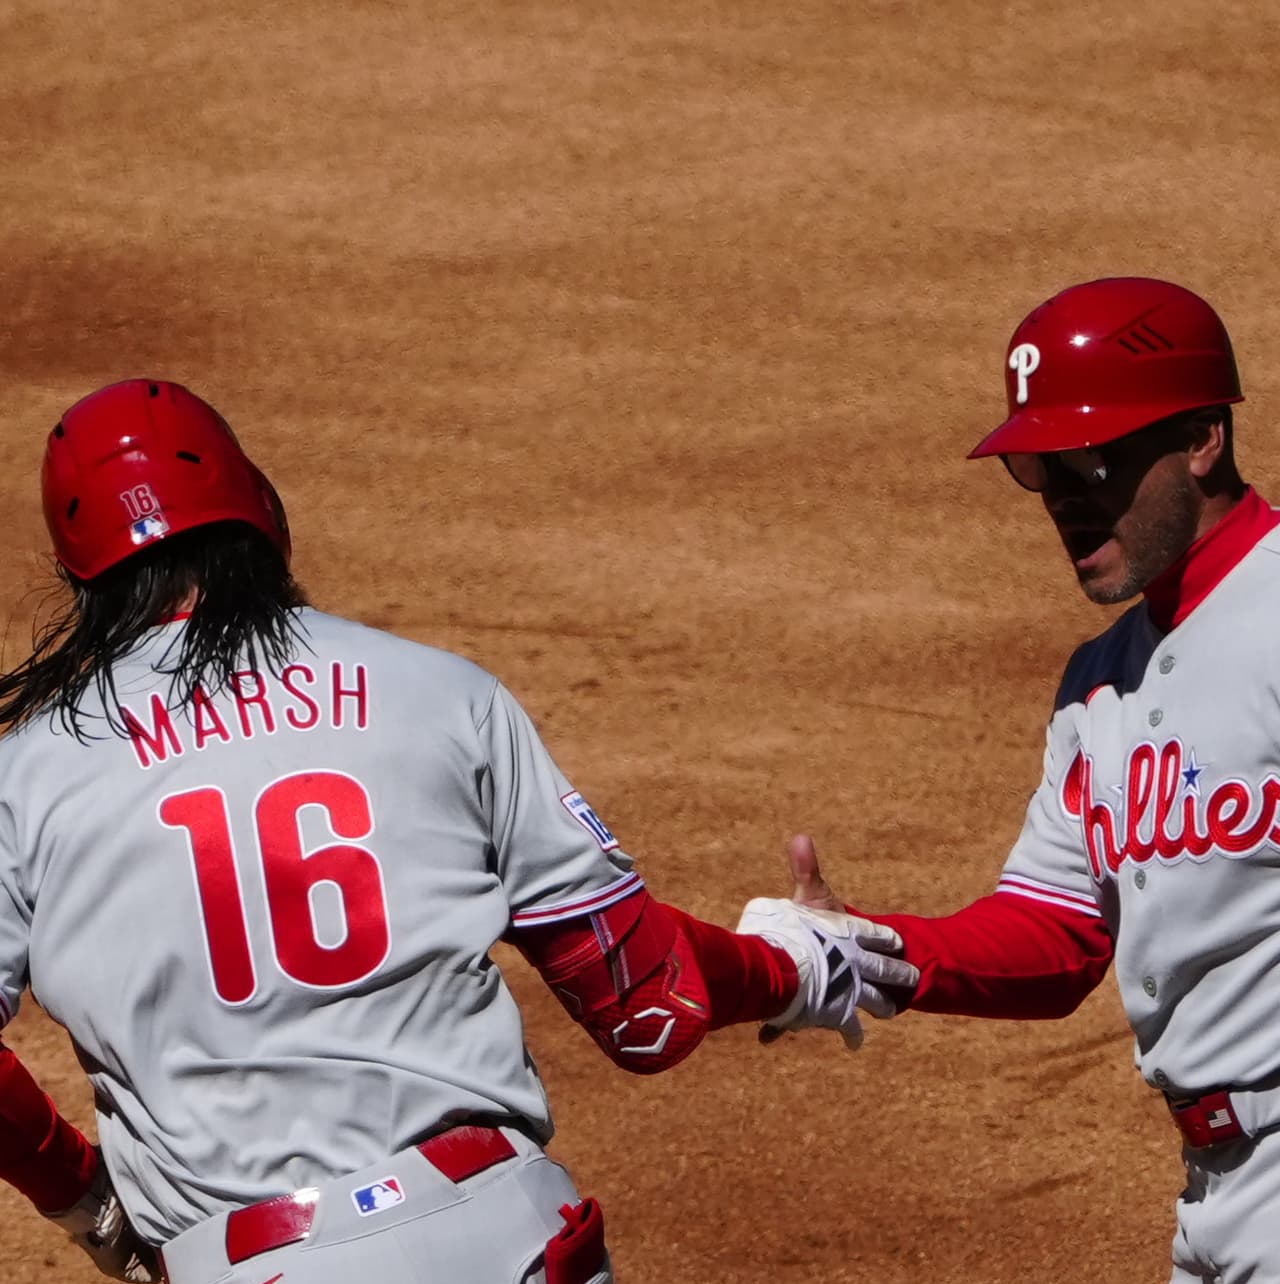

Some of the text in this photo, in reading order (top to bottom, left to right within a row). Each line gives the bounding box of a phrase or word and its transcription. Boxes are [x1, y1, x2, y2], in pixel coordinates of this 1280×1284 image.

[1009, 343, 1040, 404] P
[120, 485, 156, 519] 16
[119, 660, 369, 770] MARSH
[157, 768, 392, 1007] 16
